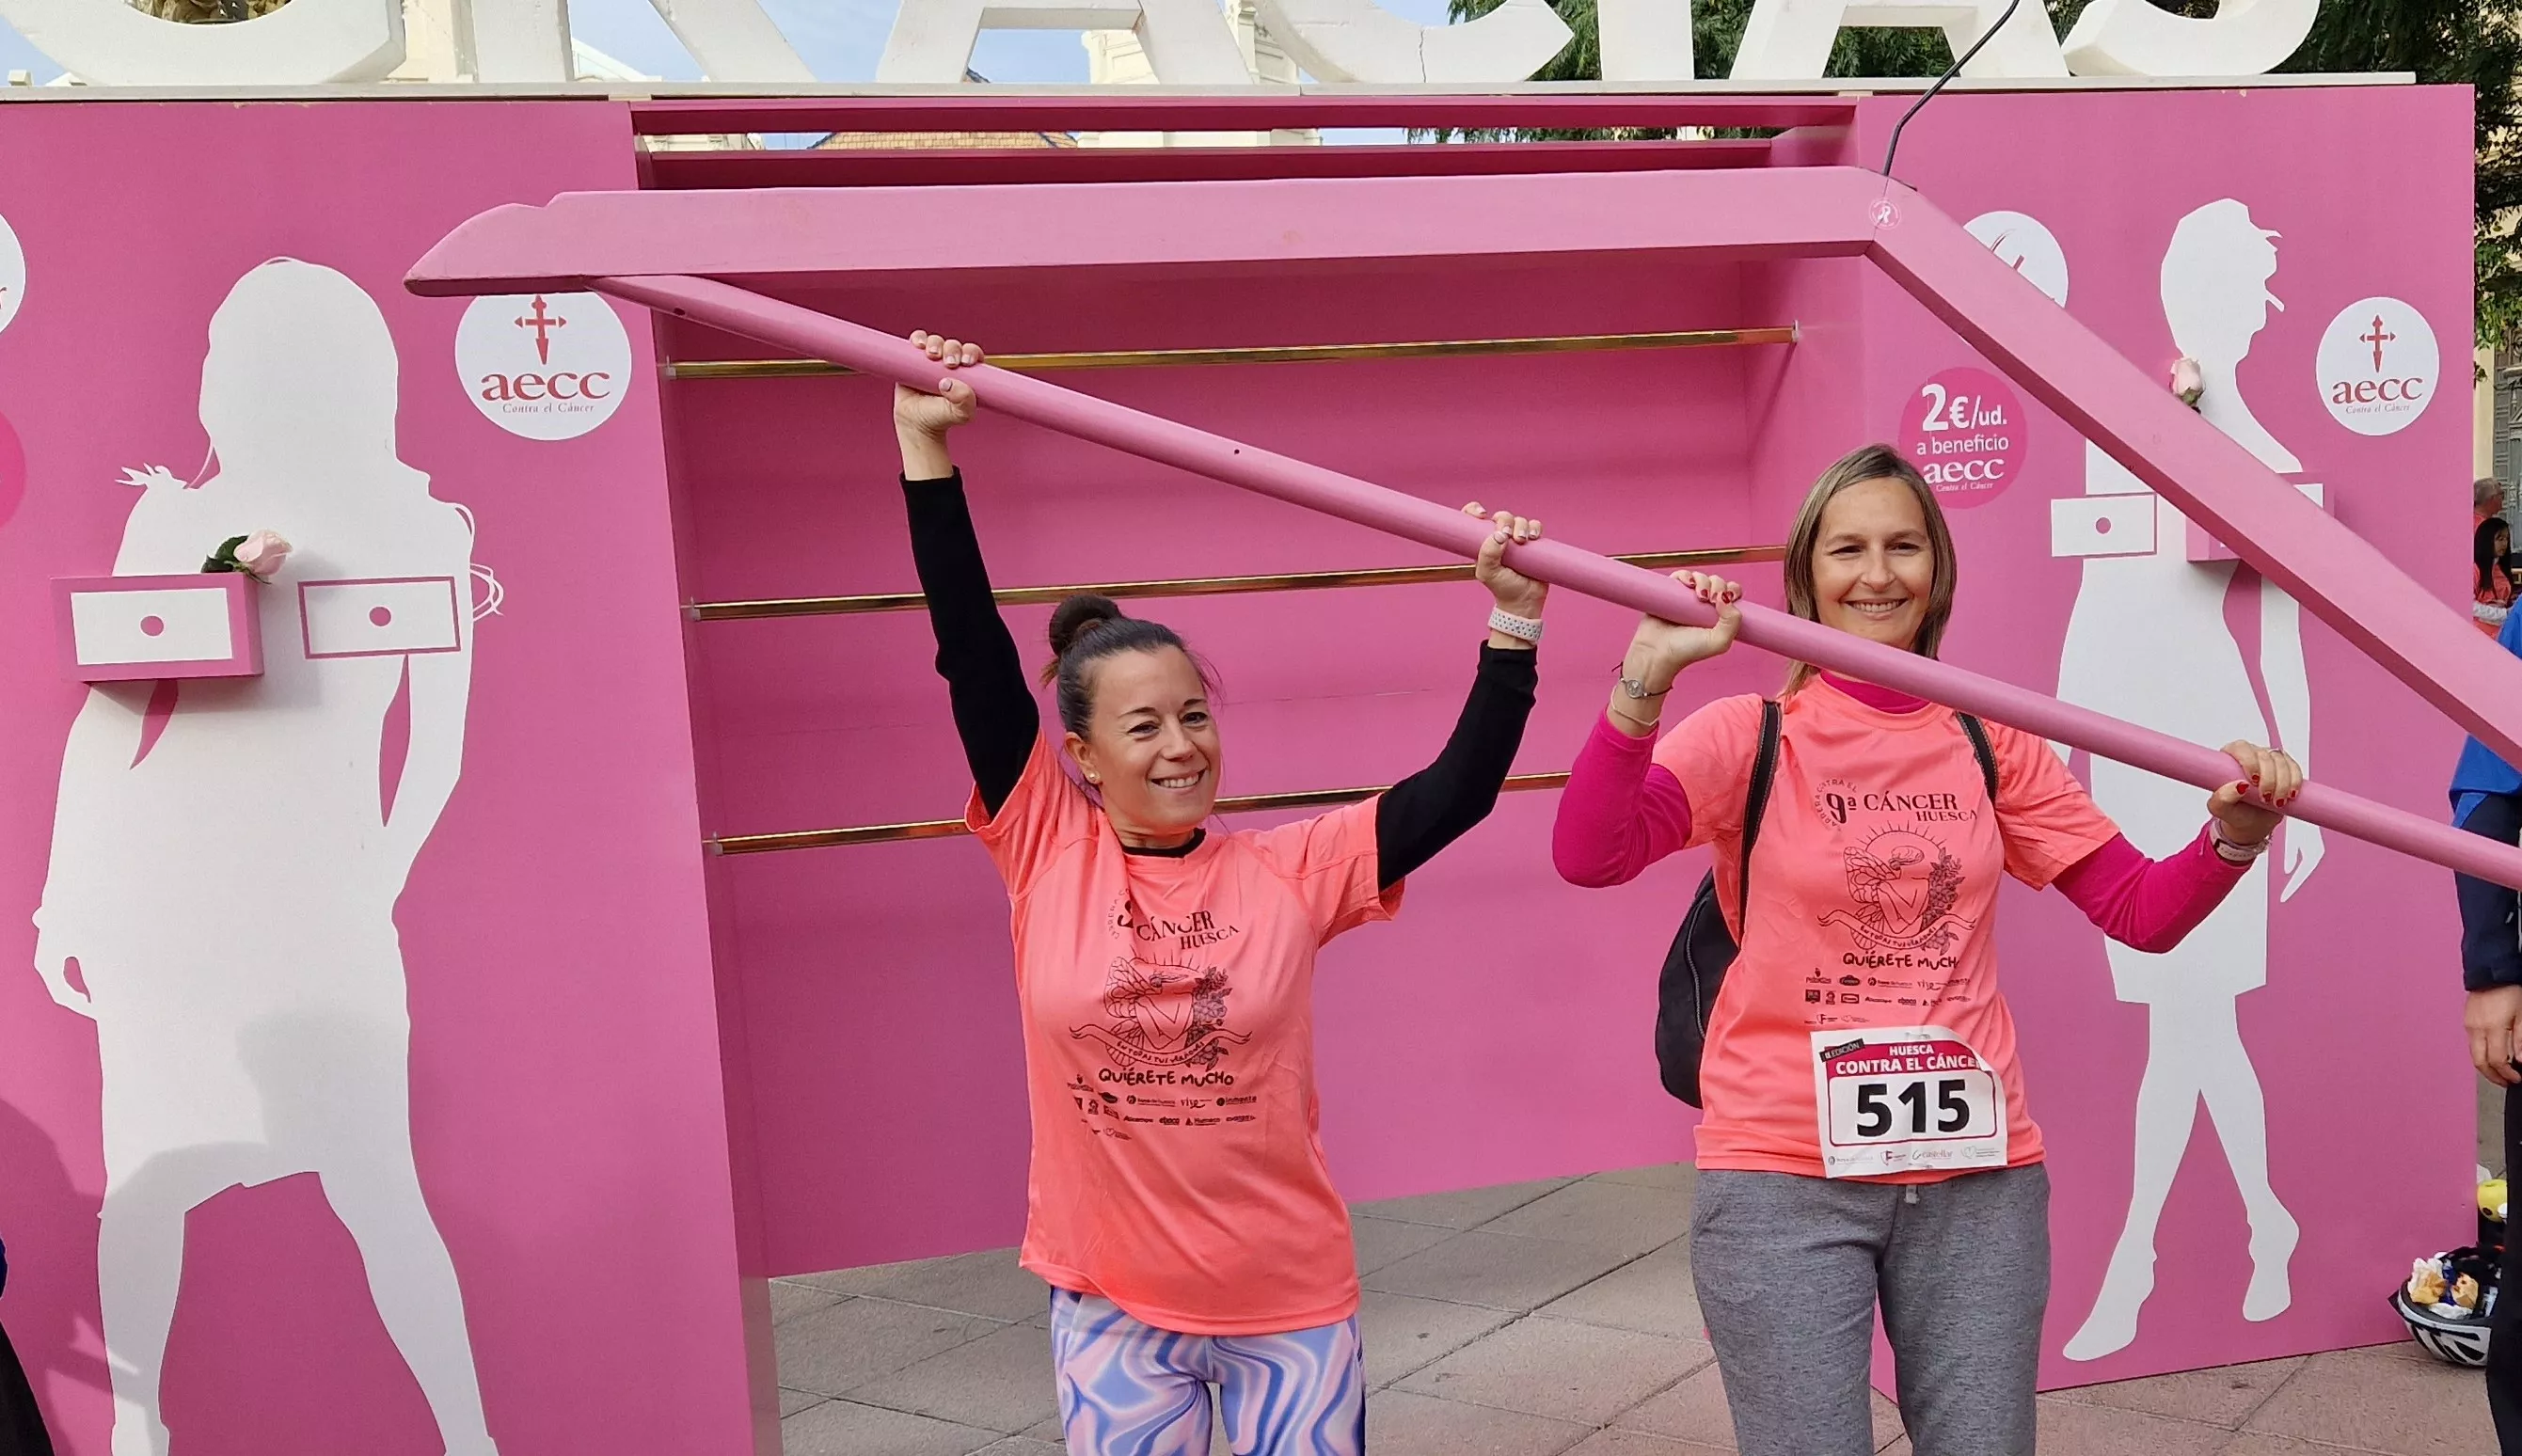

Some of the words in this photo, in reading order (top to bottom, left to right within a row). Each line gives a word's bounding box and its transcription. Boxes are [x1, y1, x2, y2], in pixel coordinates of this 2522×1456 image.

[481, 372, 611, 402] aecc
[2332, 377, 2423, 404] aecc
[502, 403, 539, 414] Contra
[543, 403, 552, 414] el
[558, 403, 595, 414] Cáncer
[1922, 383, 2008, 432] 2€/ud.
[1916, 442, 1927, 455] a
[1932, 434, 2009, 454] beneficio
[1923, 458, 2005, 484] aecc
[1864, 790, 1959, 812] CÁNCER
[1916, 810, 1977, 822] HUESCA
[1135, 910, 1216, 942] CÁNCER
[1180, 925, 1240, 950] HUESCA
[1843, 950, 1913, 969] QUIÉRETE
[1917, 956, 1959, 970] MUCH
[1831, 1041, 1861, 1057] EDICIÓN
[1889, 1044, 1934, 1056] HUESCA
[1835, 1058, 1905, 1075] CONTRA
[1906, 1057, 1924, 1071] EL
[1099, 1068, 1176, 1086] QUIÉRETE
[1181, 1070, 1234, 1087] MUCHO
[1857, 1079, 1970, 1137] 515
